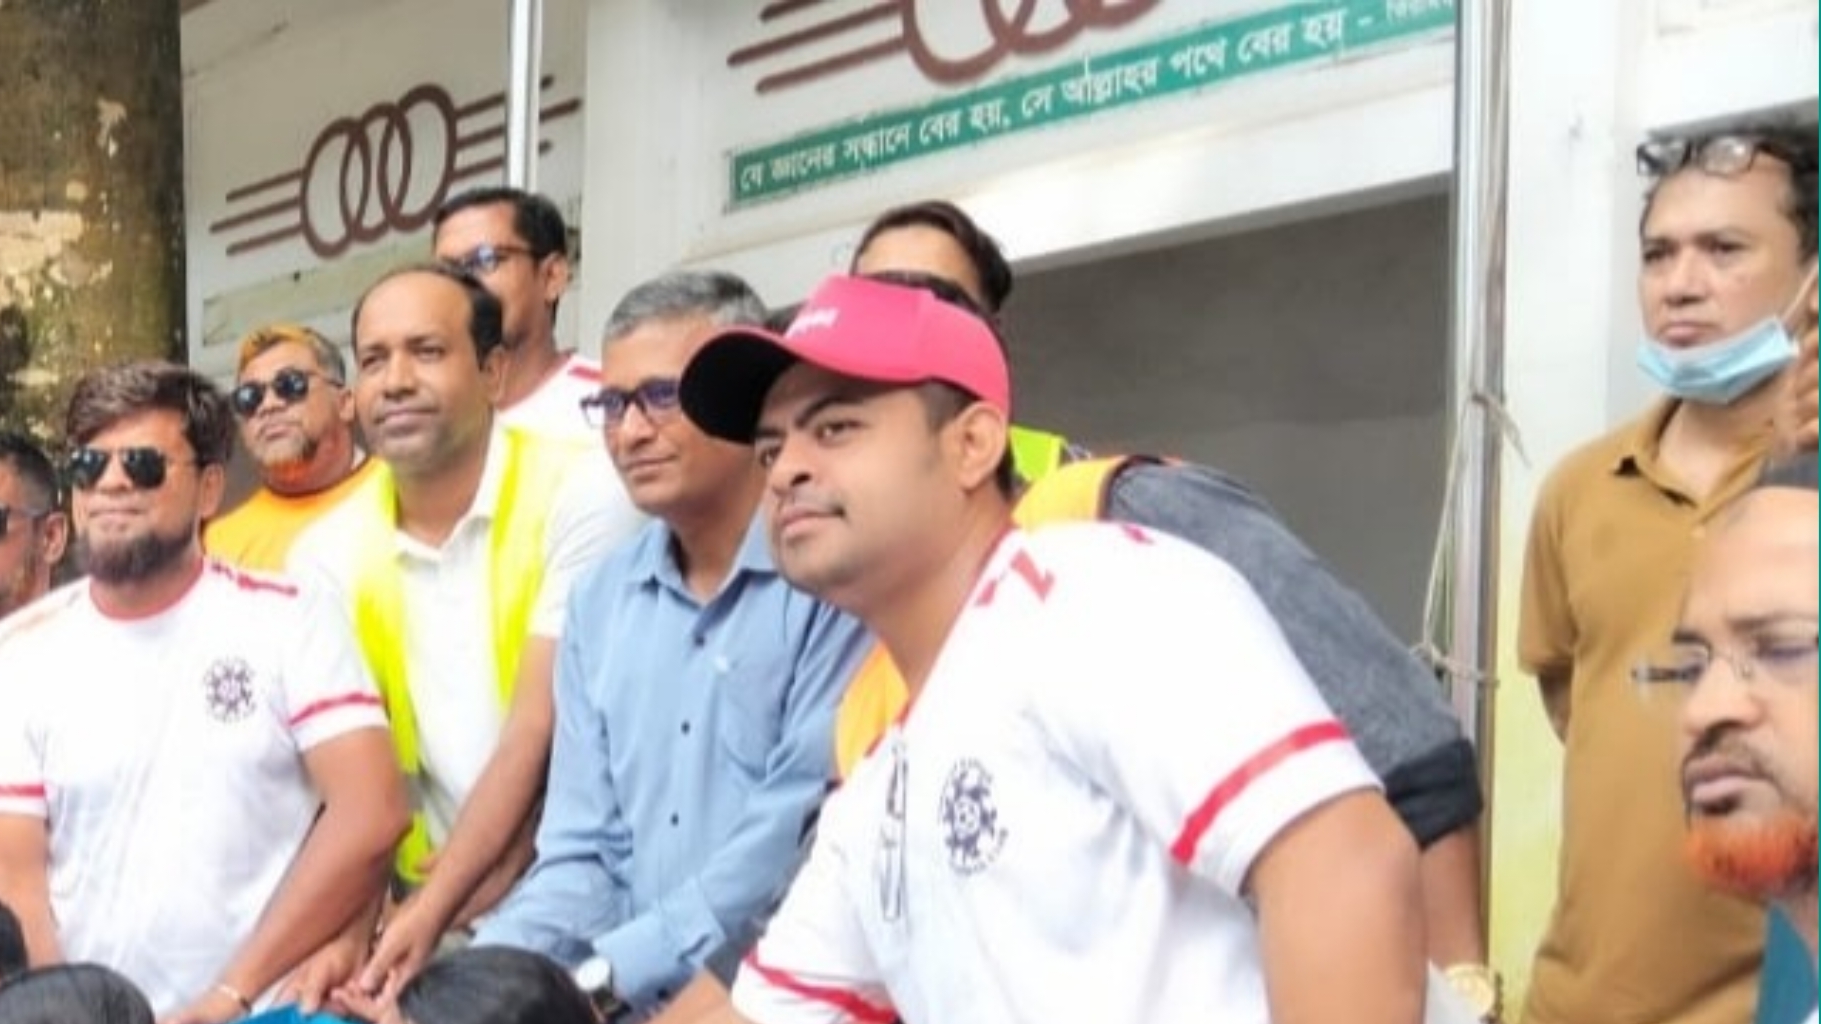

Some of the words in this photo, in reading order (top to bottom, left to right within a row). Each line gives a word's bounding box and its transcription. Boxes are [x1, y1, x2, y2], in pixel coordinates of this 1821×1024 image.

[919, 109, 964, 147] বের
[1169, 36, 1228, 79] পথে
[1236, 21, 1295, 65] বের
